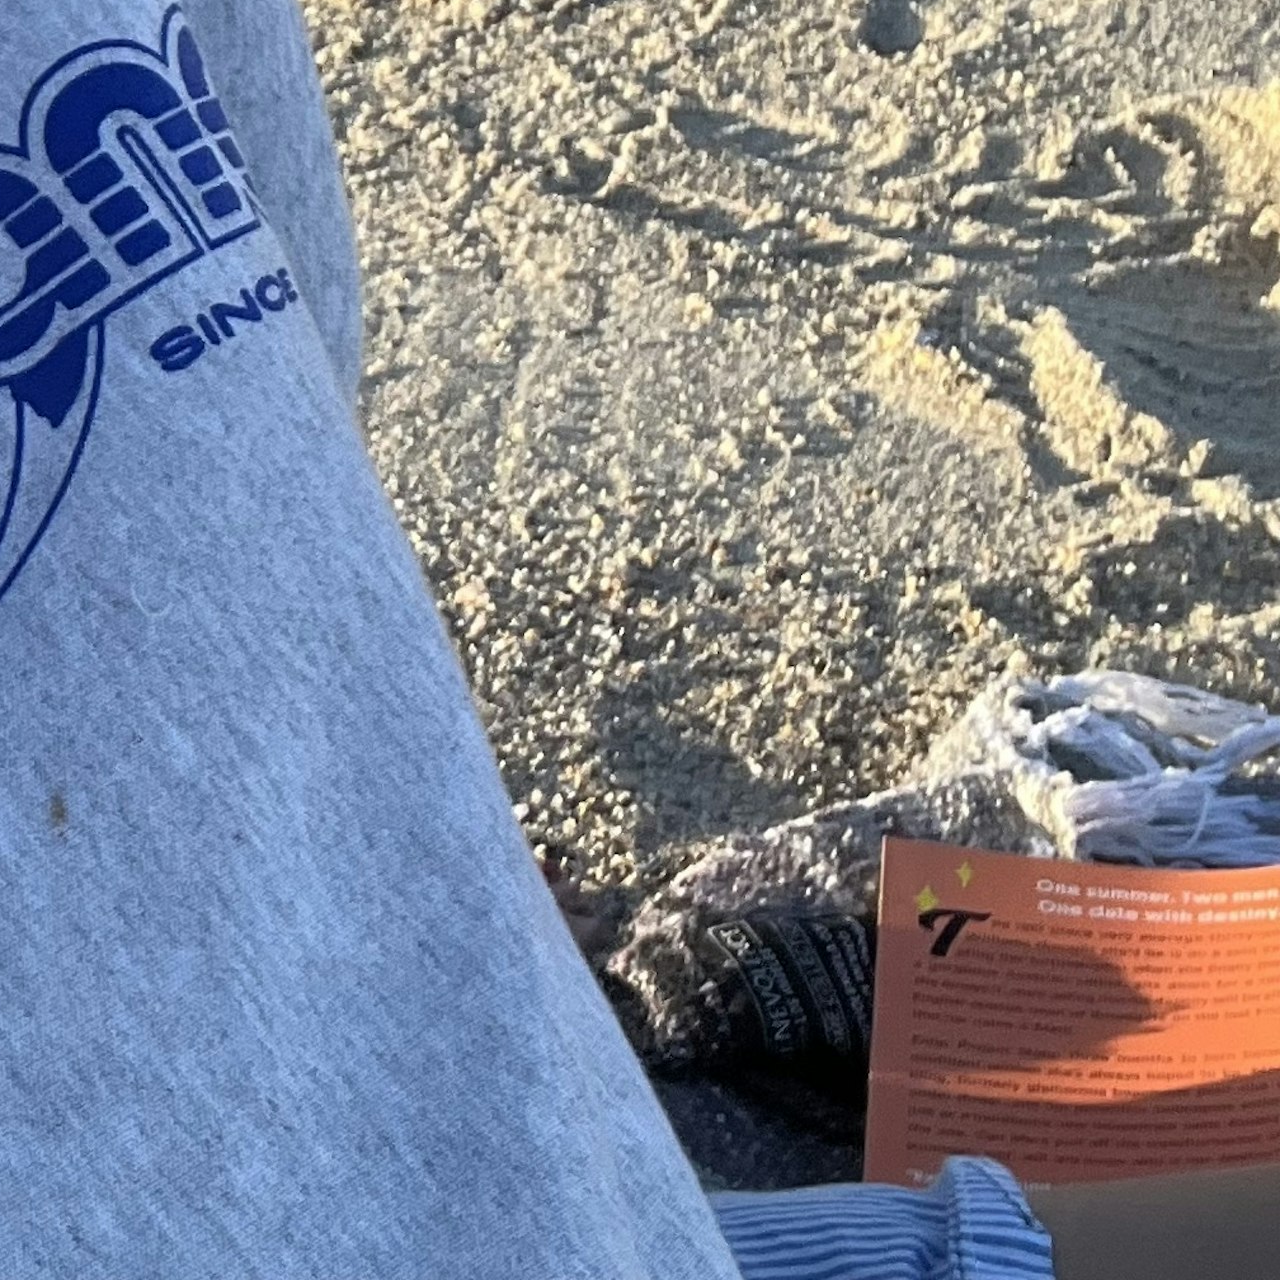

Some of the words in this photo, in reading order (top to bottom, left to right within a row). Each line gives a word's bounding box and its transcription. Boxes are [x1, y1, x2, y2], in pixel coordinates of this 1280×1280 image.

[1036, 878, 1081, 897] One
[1182, 890, 1228, 905] Two
[1037, 899, 1083, 917] One
[1088, 905, 1139, 921] date
[1144, 908, 1192, 923] with
